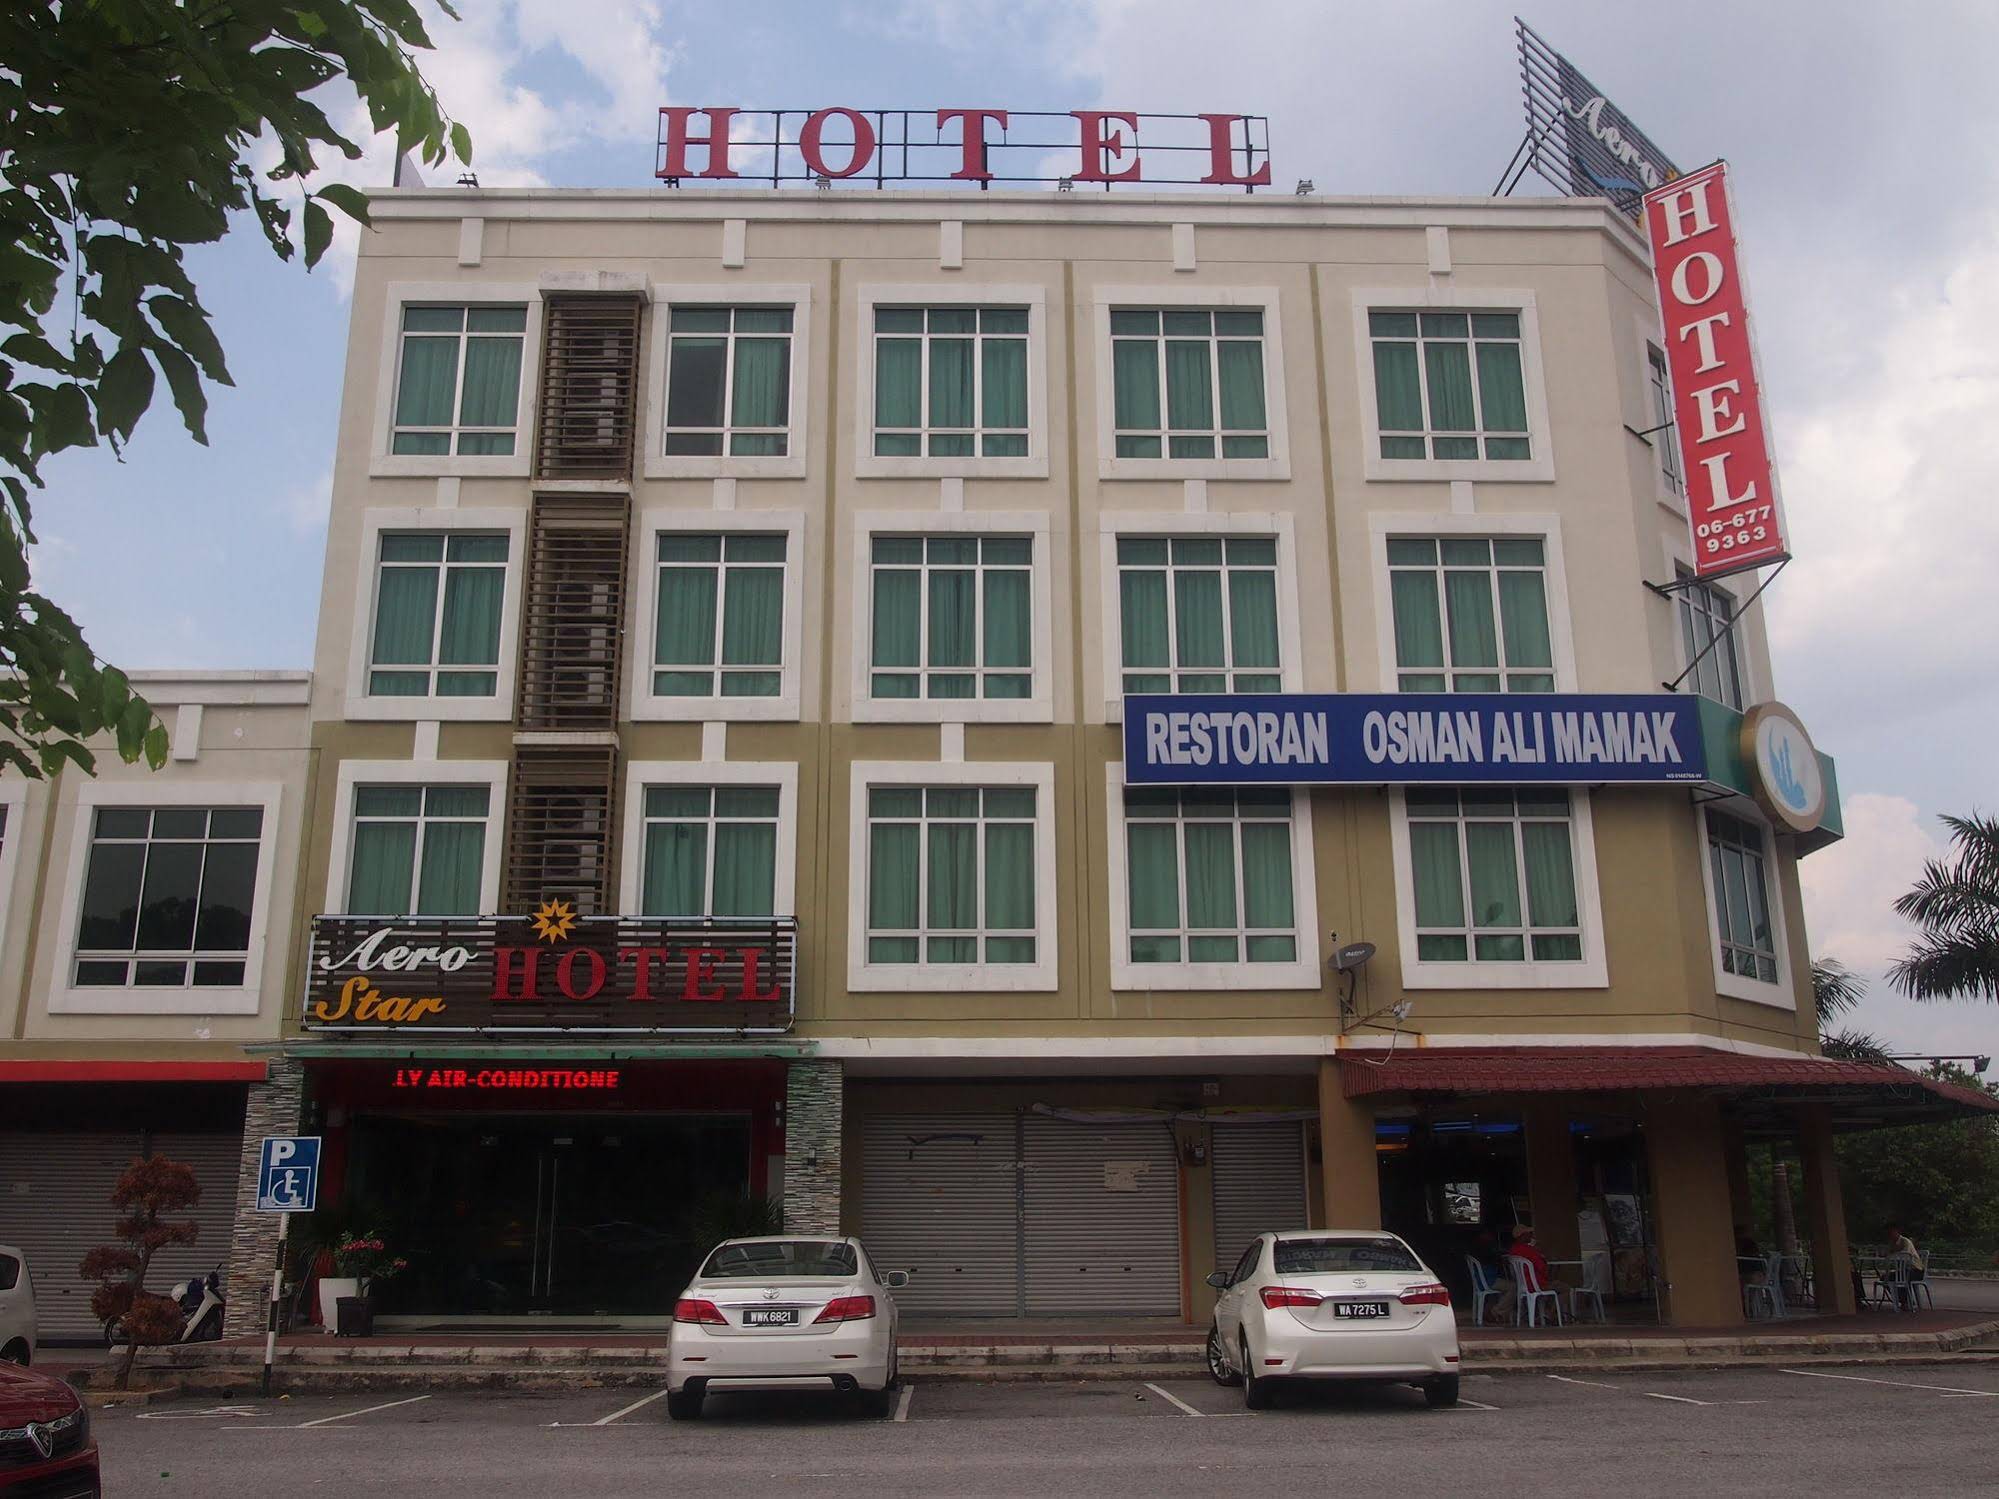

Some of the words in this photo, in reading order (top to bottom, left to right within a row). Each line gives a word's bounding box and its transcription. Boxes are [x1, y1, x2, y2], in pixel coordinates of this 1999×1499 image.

[655, 107, 1271, 185] HOTEL
[1562, 96, 1664, 189] Aero
[1657, 180, 1757, 512] HOTEL
[1697, 505, 1771, 538] 06-677
[1706, 526, 1766, 552] 9363
[1146, 711, 1329, 765] RESTORAN
[1363, 710, 1484, 764] OSMAN
[1492, 711, 1546, 763] ALI
[1551, 711, 1682, 763] MAMAK
[319, 927, 479, 972] Aero
[489, 947, 781, 1001] HOTEL
[316, 976, 447, 1022] Star
[392, 1070, 423, 1087] LY
[427, 1070, 619, 1088] AIR-CONDITIONE
[270, 1140, 296, 1166] P
